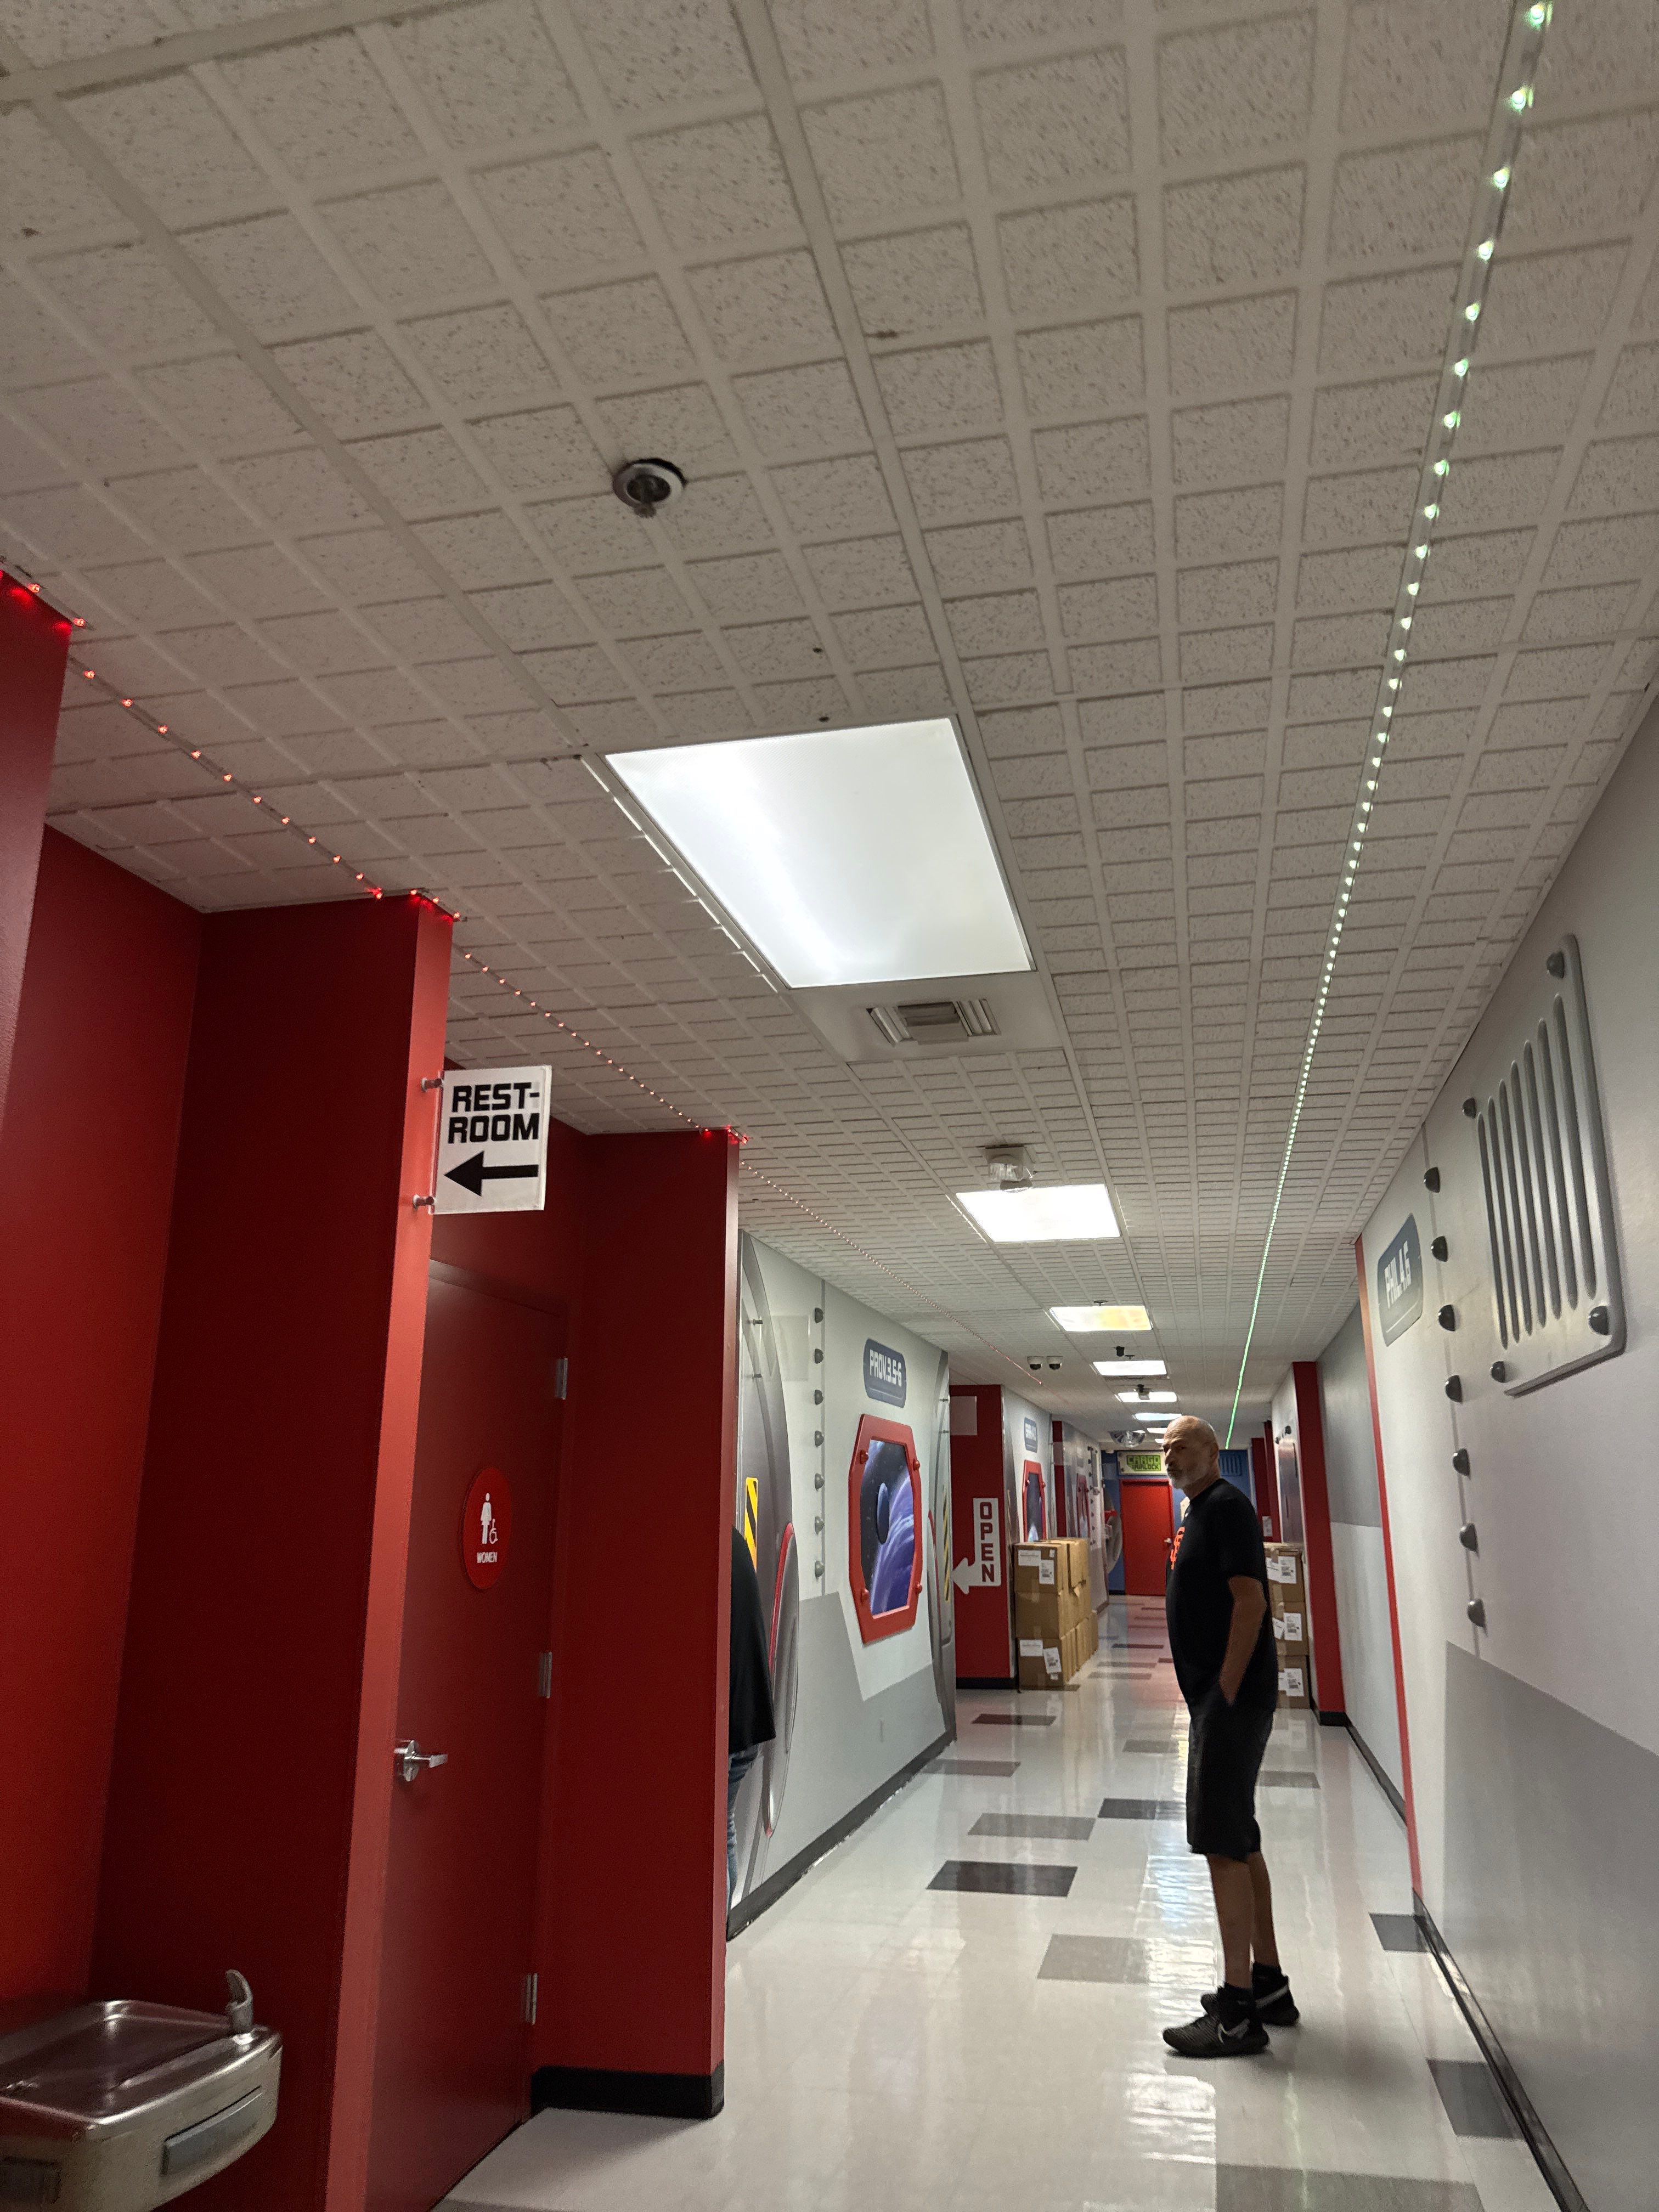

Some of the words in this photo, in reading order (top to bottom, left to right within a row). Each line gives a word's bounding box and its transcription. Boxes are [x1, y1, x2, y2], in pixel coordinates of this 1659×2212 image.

[452, 1082, 540, 1113] REST-
[448, 1113, 540, 1144] ROOM
[1127, 1455, 1161, 1465] CARGO
[476, 1551, 498, 1564] WOMEN
[979, 1502, 995, 1583] OPEN
